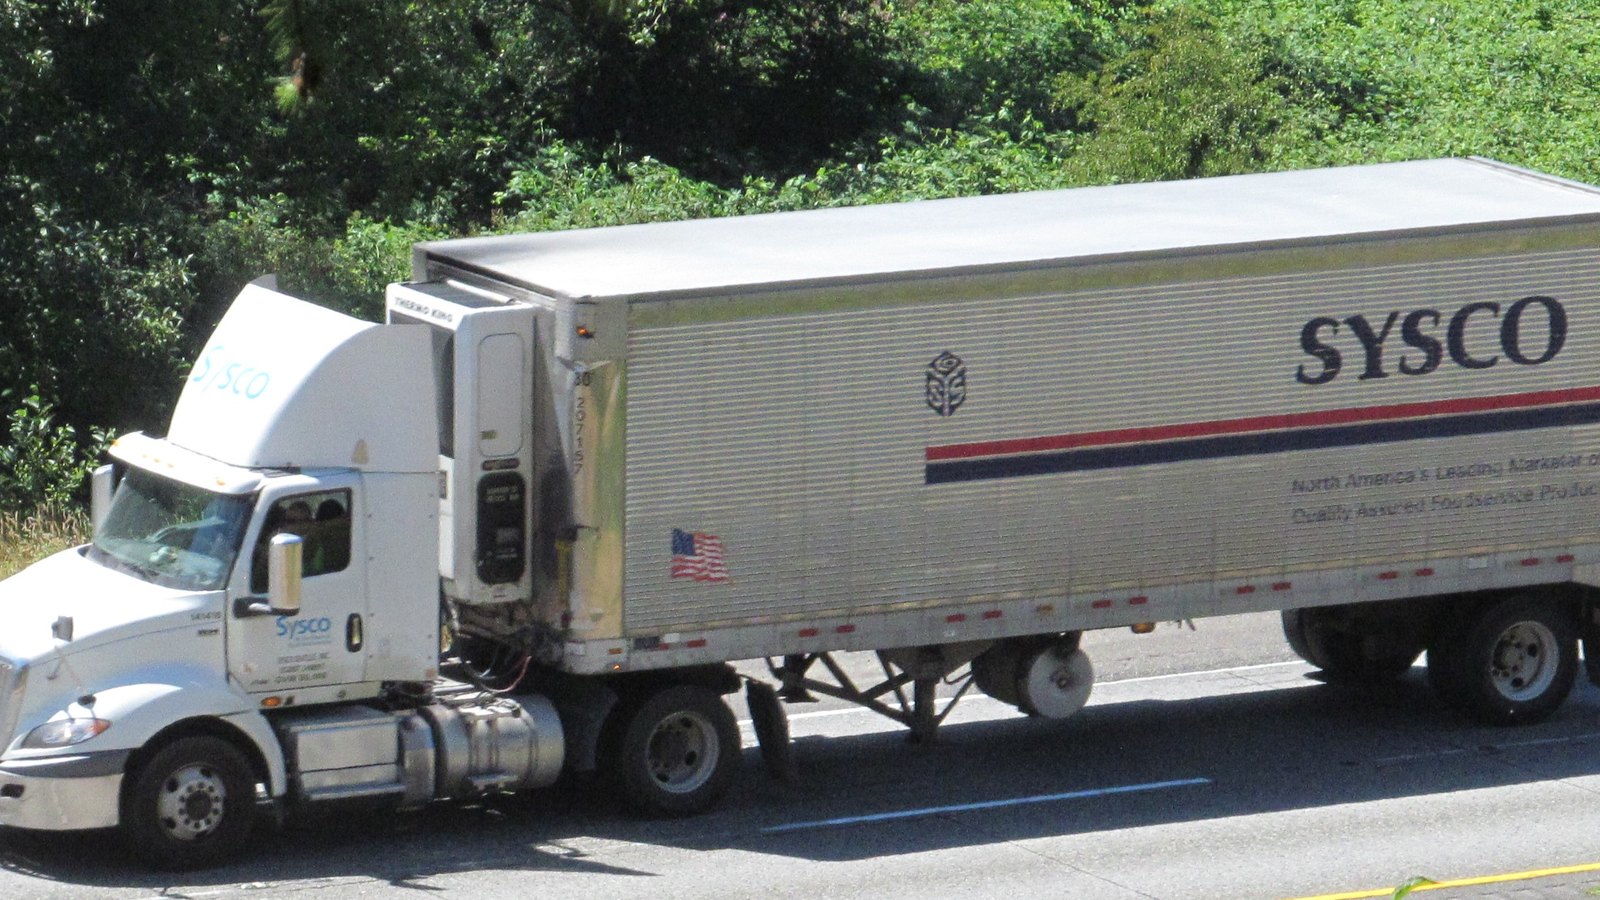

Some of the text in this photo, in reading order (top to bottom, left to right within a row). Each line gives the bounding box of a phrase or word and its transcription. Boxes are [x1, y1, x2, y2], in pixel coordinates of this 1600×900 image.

[394, 297, 453, 323] THERMO KING
[1297, 296, 1567, 385] SYSCO
[1291, 476, 1340, 493] North
[1435, 462, 1504, 481] Leading
[1291, 504, 1351, 523] Quality
[1356, 498, 1426, 518] Assured
[1540, 481, 1600, 502] Produc
